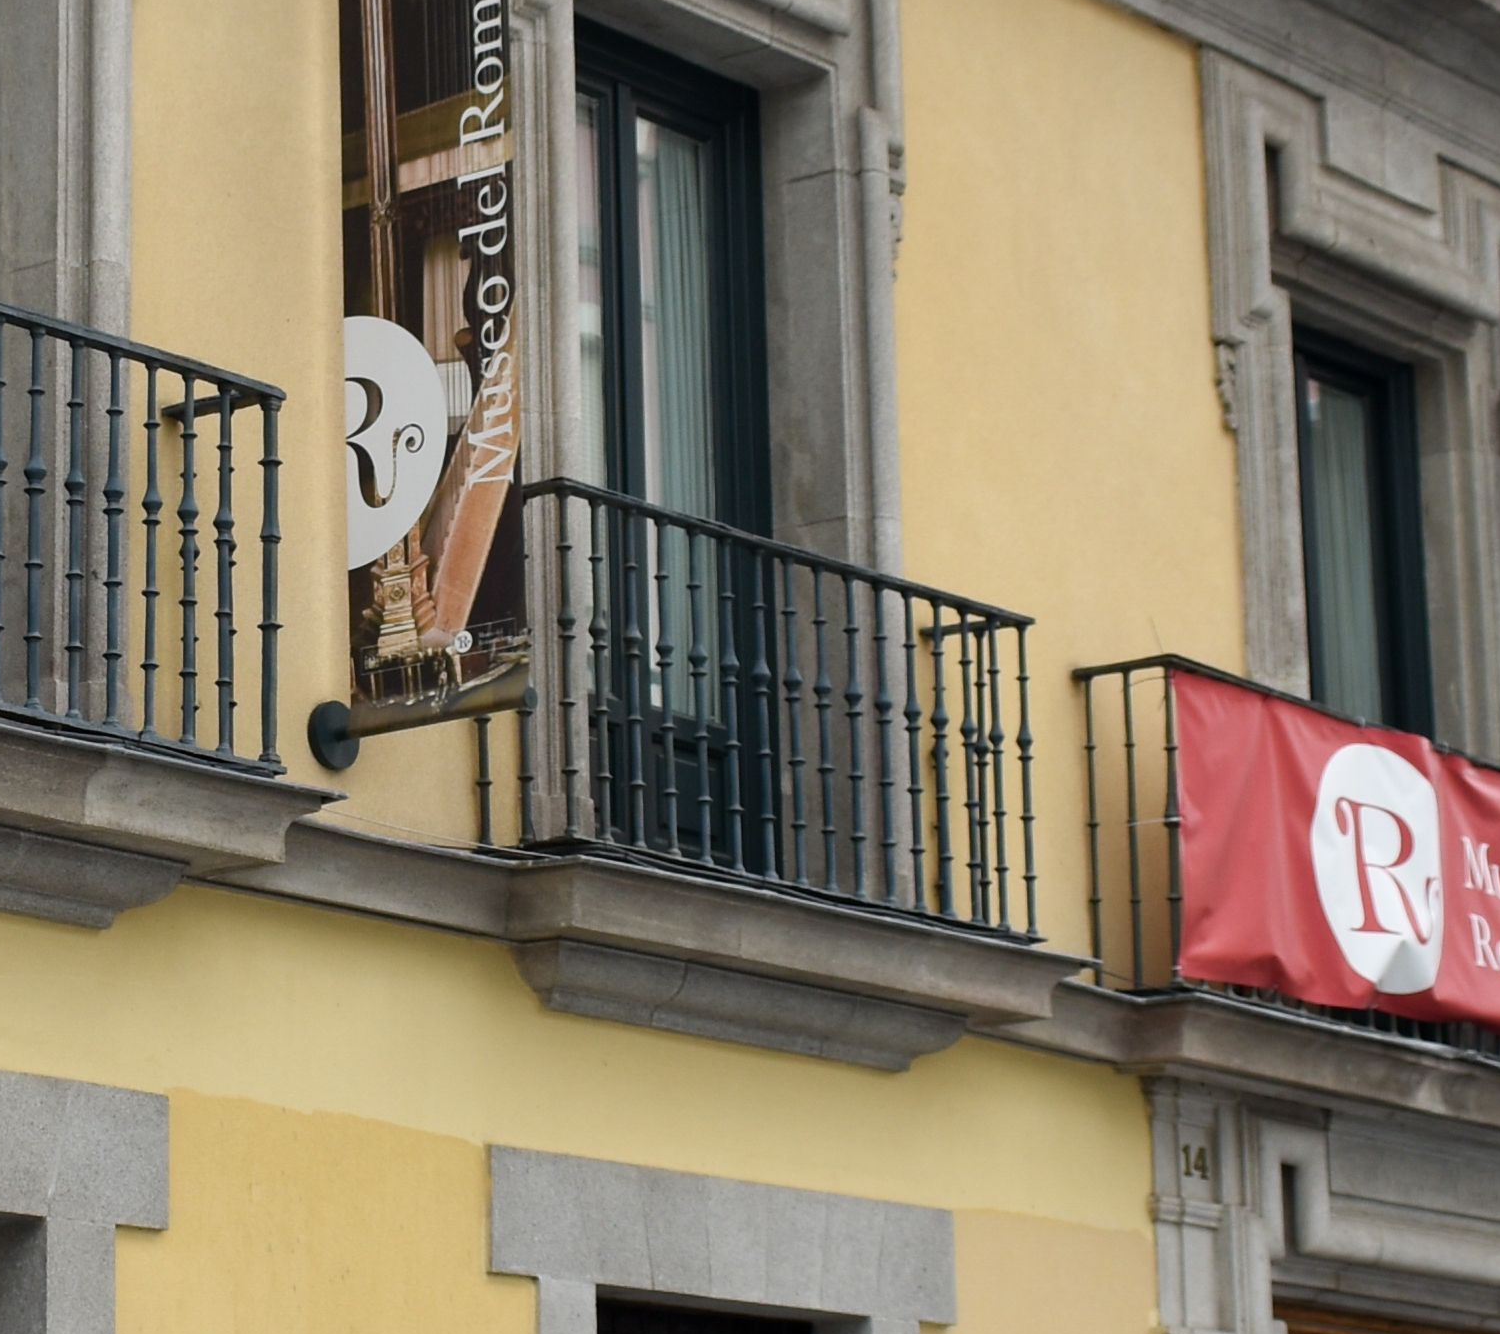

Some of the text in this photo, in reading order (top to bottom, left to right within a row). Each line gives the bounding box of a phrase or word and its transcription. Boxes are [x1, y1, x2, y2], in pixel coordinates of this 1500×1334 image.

[457, 163, 508, 256] del
[466, 274, 515, 490] Museo
[1335, 796, 1440, 945] R
[1182, 1144, 1209, 1180] 14
